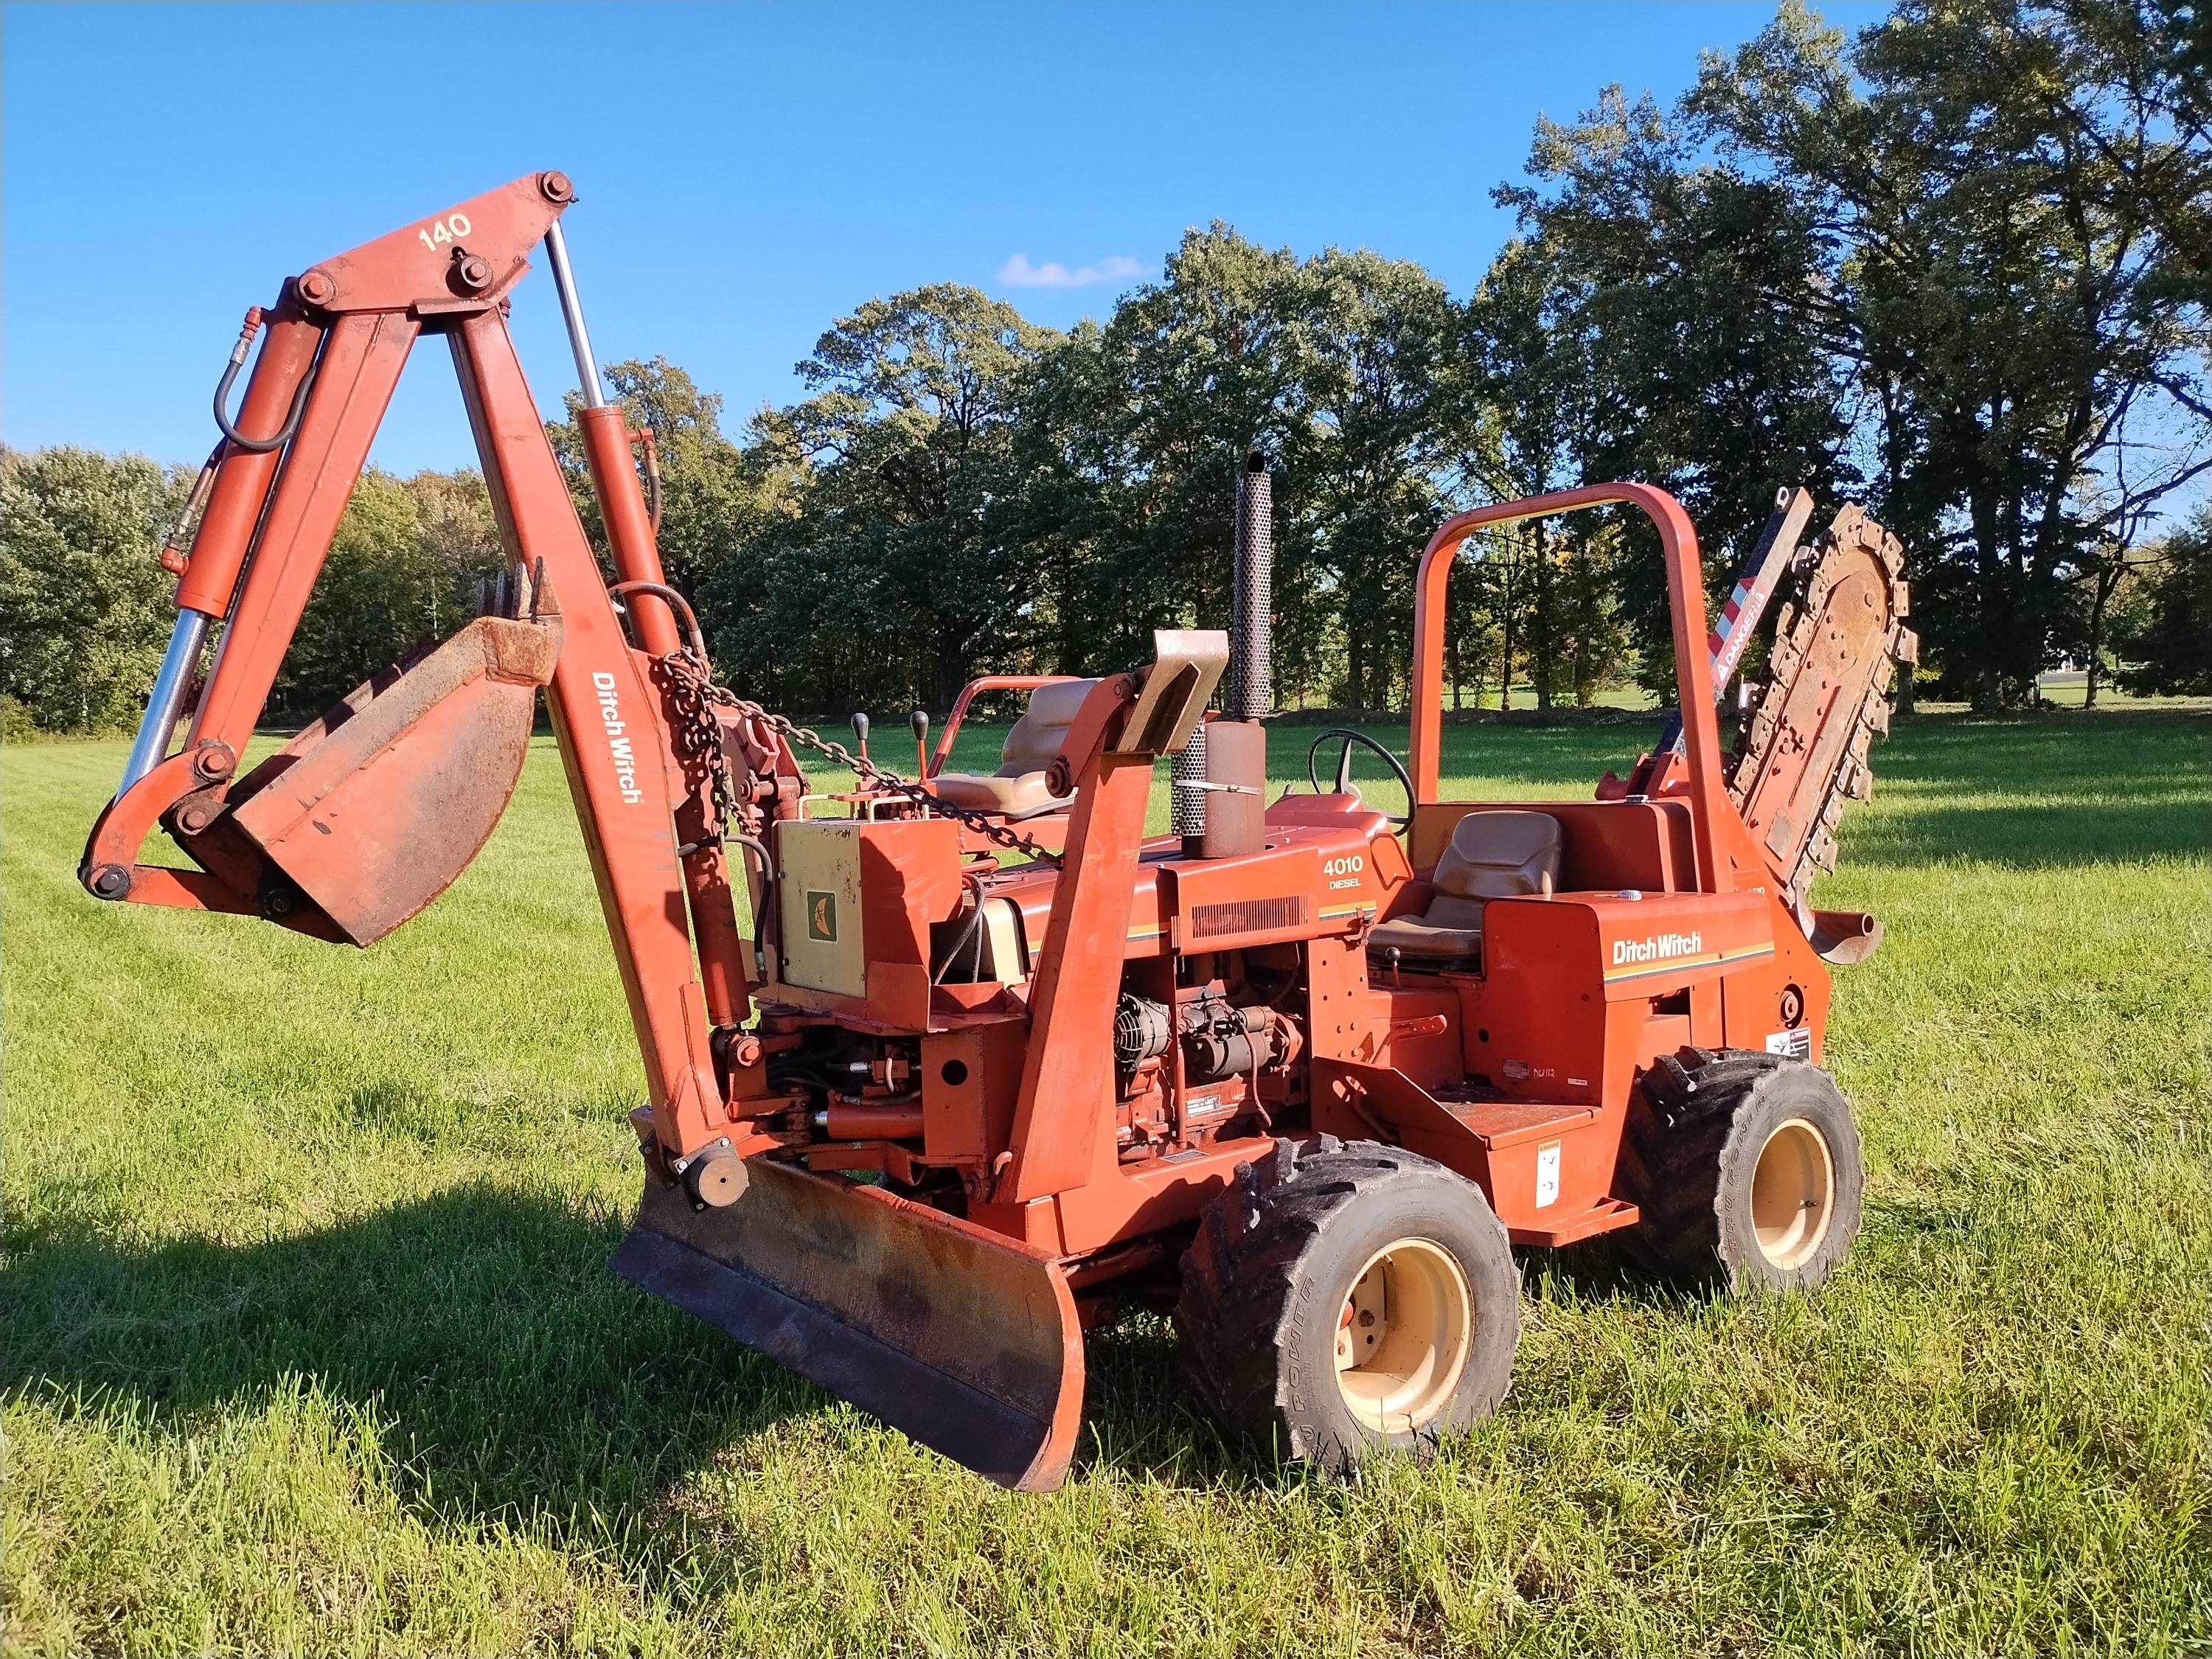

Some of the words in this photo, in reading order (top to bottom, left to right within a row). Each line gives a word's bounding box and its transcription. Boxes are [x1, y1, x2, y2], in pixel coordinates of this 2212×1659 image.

[418, 213, 472, 252] 140
[591, 672, 626, 736] Ditch
[608, 737, 642, 804] Witch
[1323, 855, 1363, 876] 4010
[1329, 877, 1362, 890] DIESEL
[1613, 936, 1657, 964] Ditch
[1657, 931, 1702, 959] Witch
[1288, 1275, 1315, 1413] POWER
